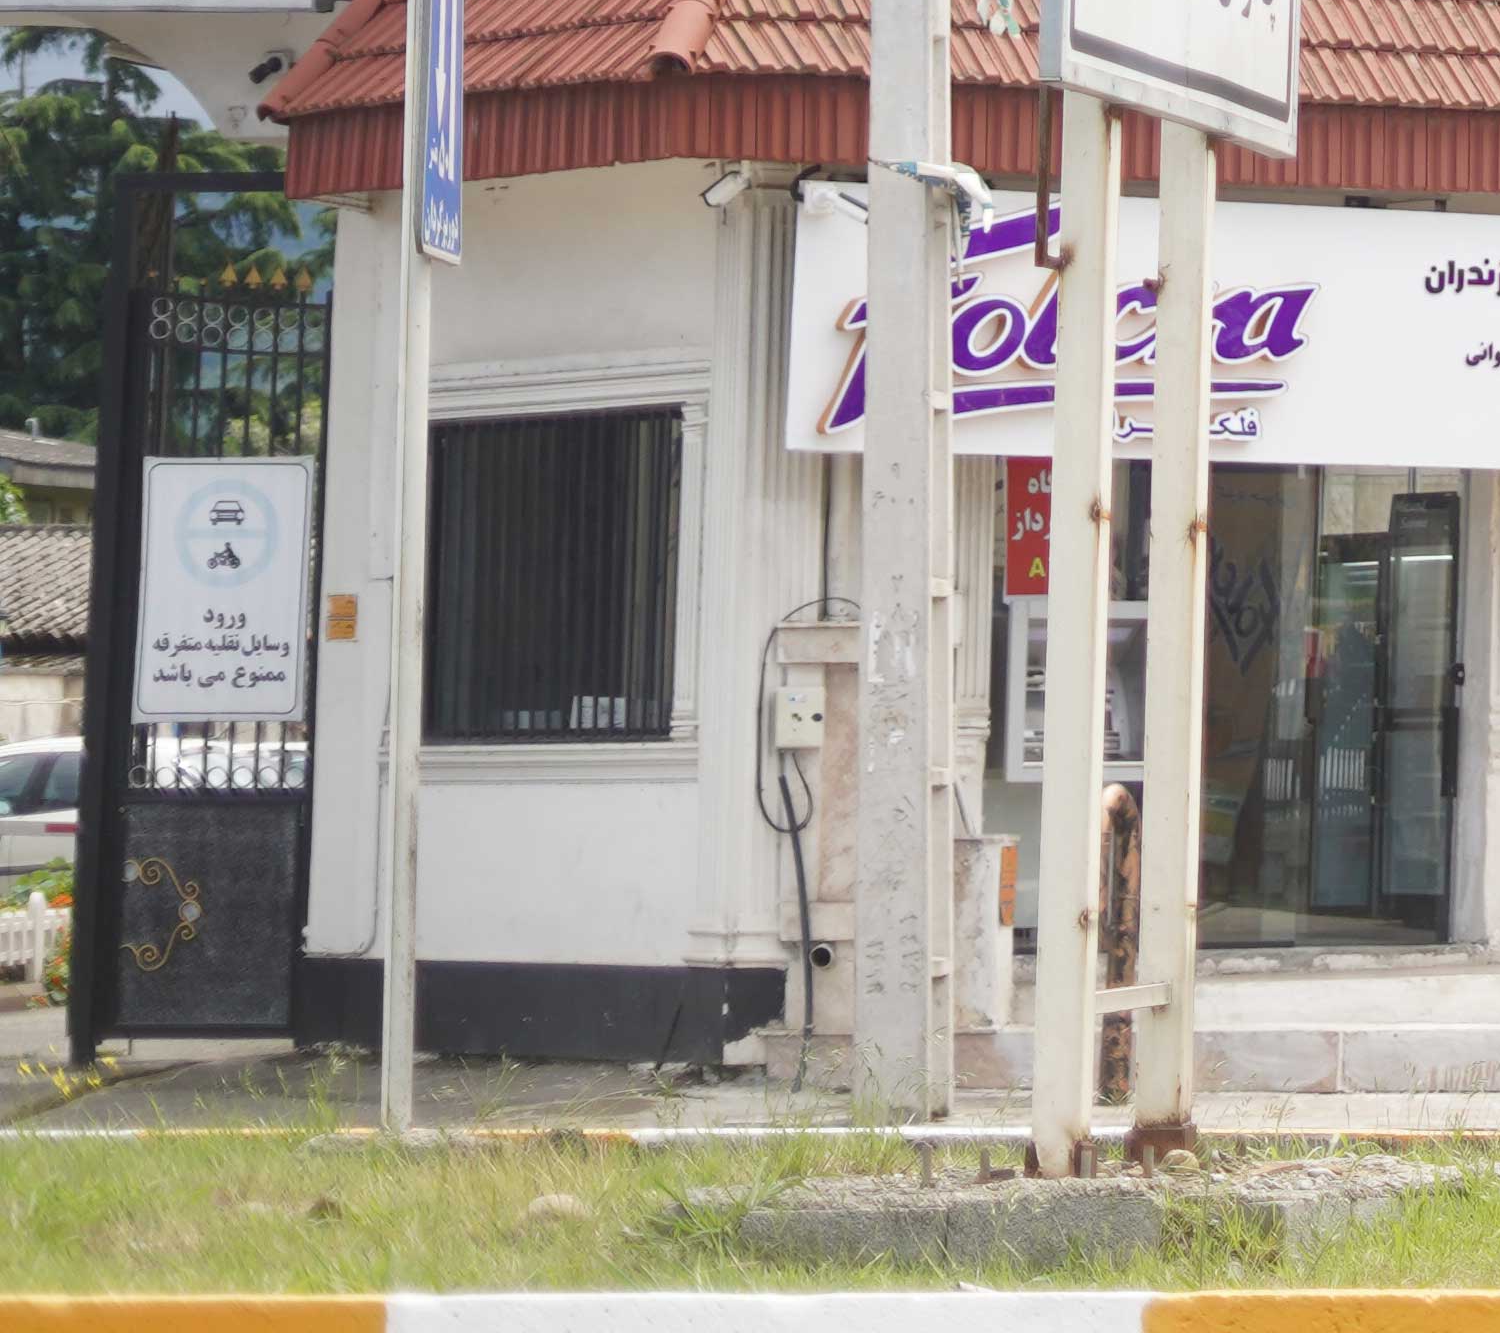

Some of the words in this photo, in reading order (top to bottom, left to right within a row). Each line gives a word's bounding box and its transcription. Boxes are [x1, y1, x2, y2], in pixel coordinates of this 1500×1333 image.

[203, 607, 247, 629] ورود
[152, 632, 202, 657] متفرقه
[204, 633, 240, 656] نقلیه
[241, 633, 290, 657] وسایل
[152, 663, 193, 686] باشد
[197, 670, 226, 688] می
[232, 665, 287, 688] ممنوع
